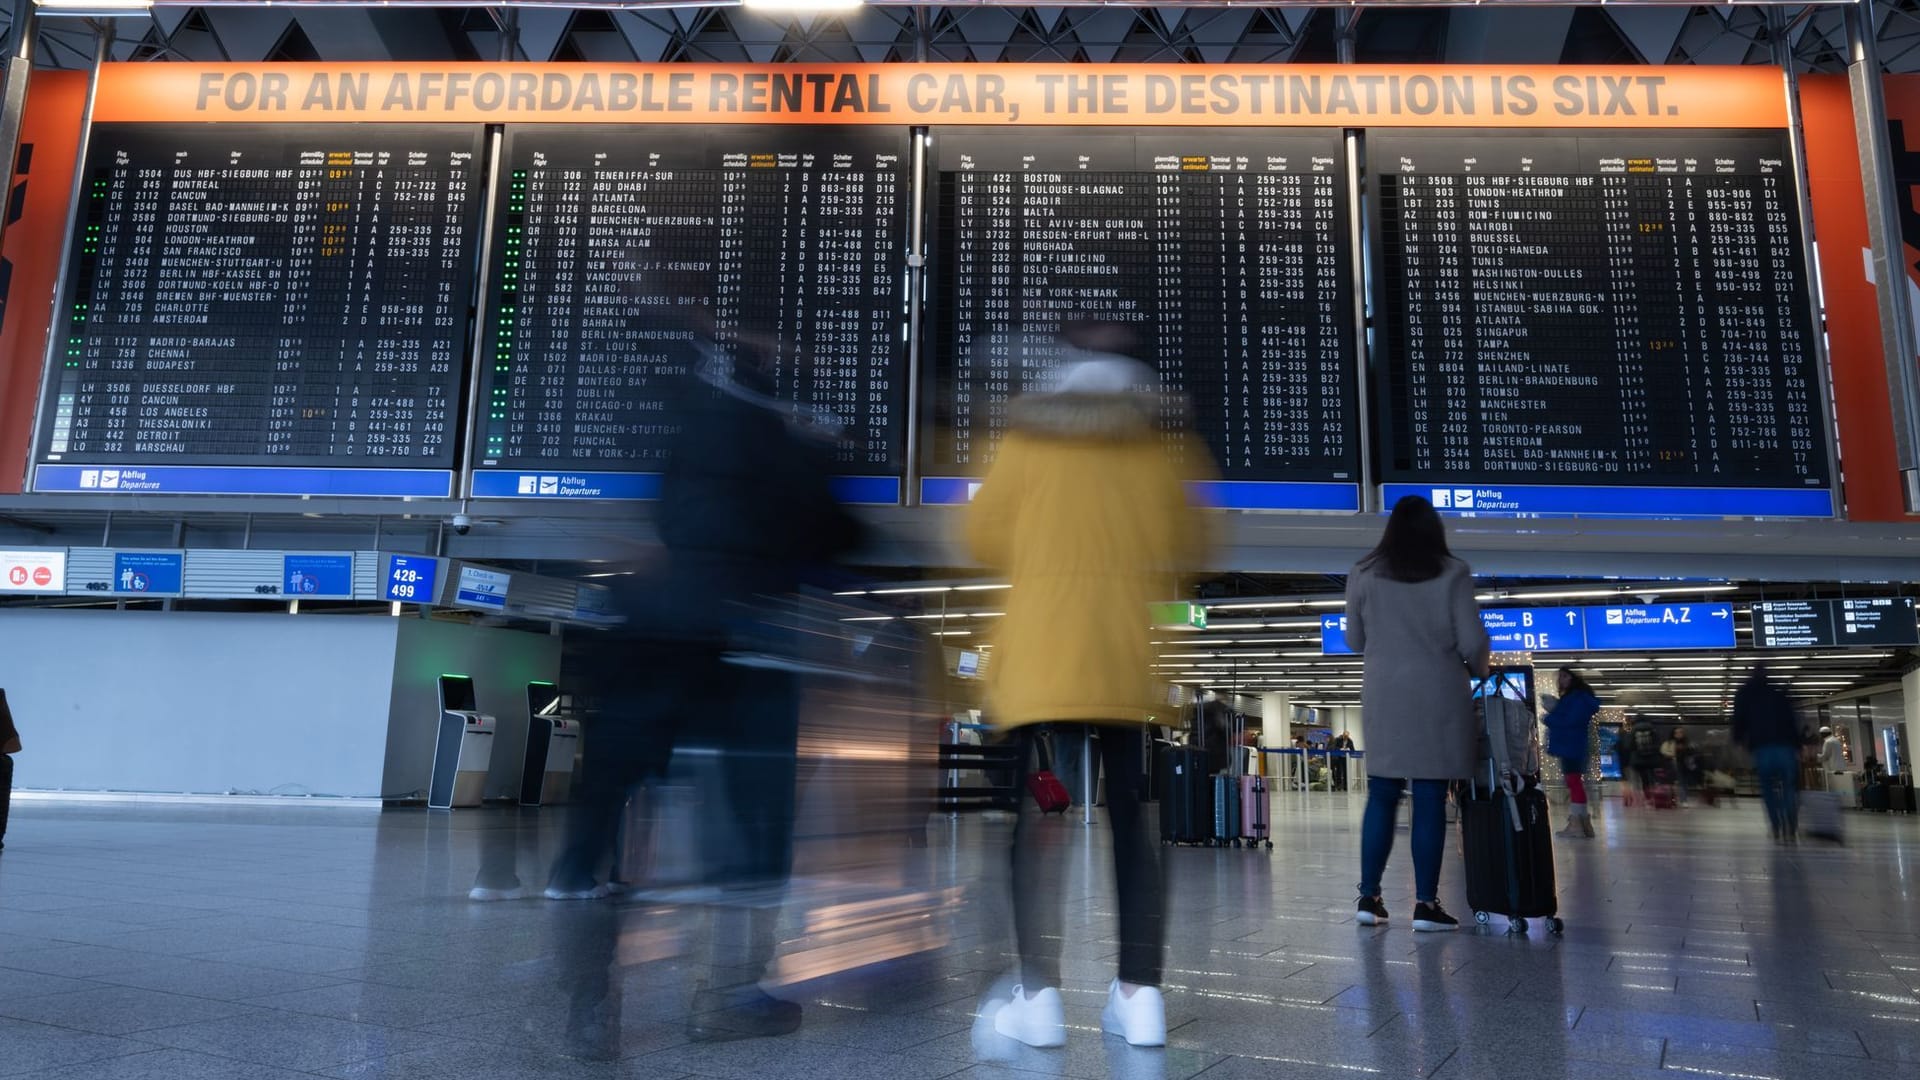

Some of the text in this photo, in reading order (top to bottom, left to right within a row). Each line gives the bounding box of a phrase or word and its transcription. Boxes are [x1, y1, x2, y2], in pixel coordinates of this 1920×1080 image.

[196, 72, 1678, 122] FOR AN AFFORDABLE RENTAL CAR, THE DESTINATION IS SIXT.
[115, 169, 293, 178] LH 3504 DUS HBF-SIEGBURG HBF
[595, 171, 895, 182] TENERIFFA-SUR 474-488 B13
[993, 174, 1061, 183] 422 BOSTON
[173, 180, 467, 190] MONTREAL 717-722 B42
[1403, 176, 1594, 186] LH 3508 DUS HBF-SIEGBURG HBF
[593, 182, 864, 193] ABU DHABI 863-868
[988, 185, 1301, 196] 1094 TOULOUSE-BLAGNAC 259-335
[1403, 187, 1751, 198] BA 903 LONDON-HEATHROW 903-906
[171, 191, 435, 201] CANCUN 752-786
[592, 193, 635, 202] ATLANTA
[1024, 196, 1061, 205] AGADIR
[169, 202, 289, 211] BASEL BAD-MANNHEIM-K
[1404, 199, 1752, 210] LBT 235 TUNIS 955-957
[591, 205, 894, 216] BARCELONA A34
[1024, 208, 1055, 216] MALTA
[132, 213, 288, 223] 3586 DORTMUND-SIEGBURG-DU
[590, 216, 714, 226] MUENCHEN-WUERZBURG-N
[1468, 211, 1786, 222] ROM-FIUMICINO D25
[1024, 219, 1143, 229] TEL AVIV-BEN GURION
[1469, 222, 1788, 233] NAIROBI B55
[166, 224, 462, 235] HOUSTON 259-335 Z50
[589, 227, 862, 238] DOHA-HAMAD 941-948
[165, 235, 255, 245] LONDON-HEATHROW
[1023, 230, 1111, 240] DRESDEN-ERFURT
[1470, 233, 1521, 243] BRUESSEL
[588, 238, 650, 247] MARSA ALAM
[1024, 242, 1074, 251] HURGHADA
[163, 247, 241, 256] SAN FRANCISCO
[589, 250, 625, 259] TAIPEH
[1471, 245, 1549, 255] TOKIO-HANEDA
[161, 258, 283, 268] MUENCHEN-STUTTGART-U
[1023, 253, 1105, 263] ROM-FIUMICINO
[1023, 265, 1119, 274] OSLO-GARDERMOEN
[1472, 269, 1583, 278] WASHINGTON-DULLES
[586, 272, 642, 282] VANCOUVER
[1023, 276, 1048, 285] RIGA
[1473, 280, 1523, 289] HELSINKI
[1023, 288, 1305, 300] NEW YORK-NEWARK 489-498
[1474, 292, 1605, 302] MUENCHEN-WUERZBURG-N
[125, 303, 209, 312] 705 CHARLOTTE
[1023, 299, 1112, 309] DORTMUND-KOELN
[583, 307, 640, 316] HERAKLION
[153, 315, 454, 326] AMSTERDAM D23
[582, 318, 626, 327] BAHRAIN
[581, 330, 694, 340] BERLIN-BRANDENBURG
[1476, 327, 1528, 337] SINGAPUR
[150, 337, 236, 347] MADRID-BARAJAS
[1478, 339, 1510, 348] TAMPA
[148, 349, 190, 358] CHENNAI
[580, 353, 668, 363] MADRID-BARAJAS
[1478, 351, 1530, 361] SHENZHEN
[146, 360, 195, 370] BUDAPEST
[1478, 363, 1570, 373] MAILAND-LINATE
[1479, 375, 1598, 386] BERLIN-BRANDENBURG
[143, 383, 235, 394] DUESSELDORF HBF
[577, 388, 615, 398] DUBLIN
[1480, 400, 1547, 409] MANCHESTER
[140, 407, 208, 417] LOS ANGELES
[1481, 412, 1508, 421] WIEN
[139, 419, 211, 429] THESSALONIKI
[1482, 424, 1582, 434] TORONTO-PEARSON
[137, 431, 180, 440] DETROIT
[1483, 436, 1542, 446] AMSTERDAM
[135, 442, 185, 452] WARSCHAU
[122, 470, 146, 480] Abflug
[120, 480, 160, 489] Departures
[561, 476, 586, 486] Abflug
[560, 487, 600, 496] Departures
[1476, 490, 1502, 499] Abflug
[1476, 501, 1519, 509] Departures
[393, 569, 423, 582] 428-
[392, 584, 415, 597] 499
[1624, 609, 1646, 617] Abflug
[1522, 612, 1533, 627] B
